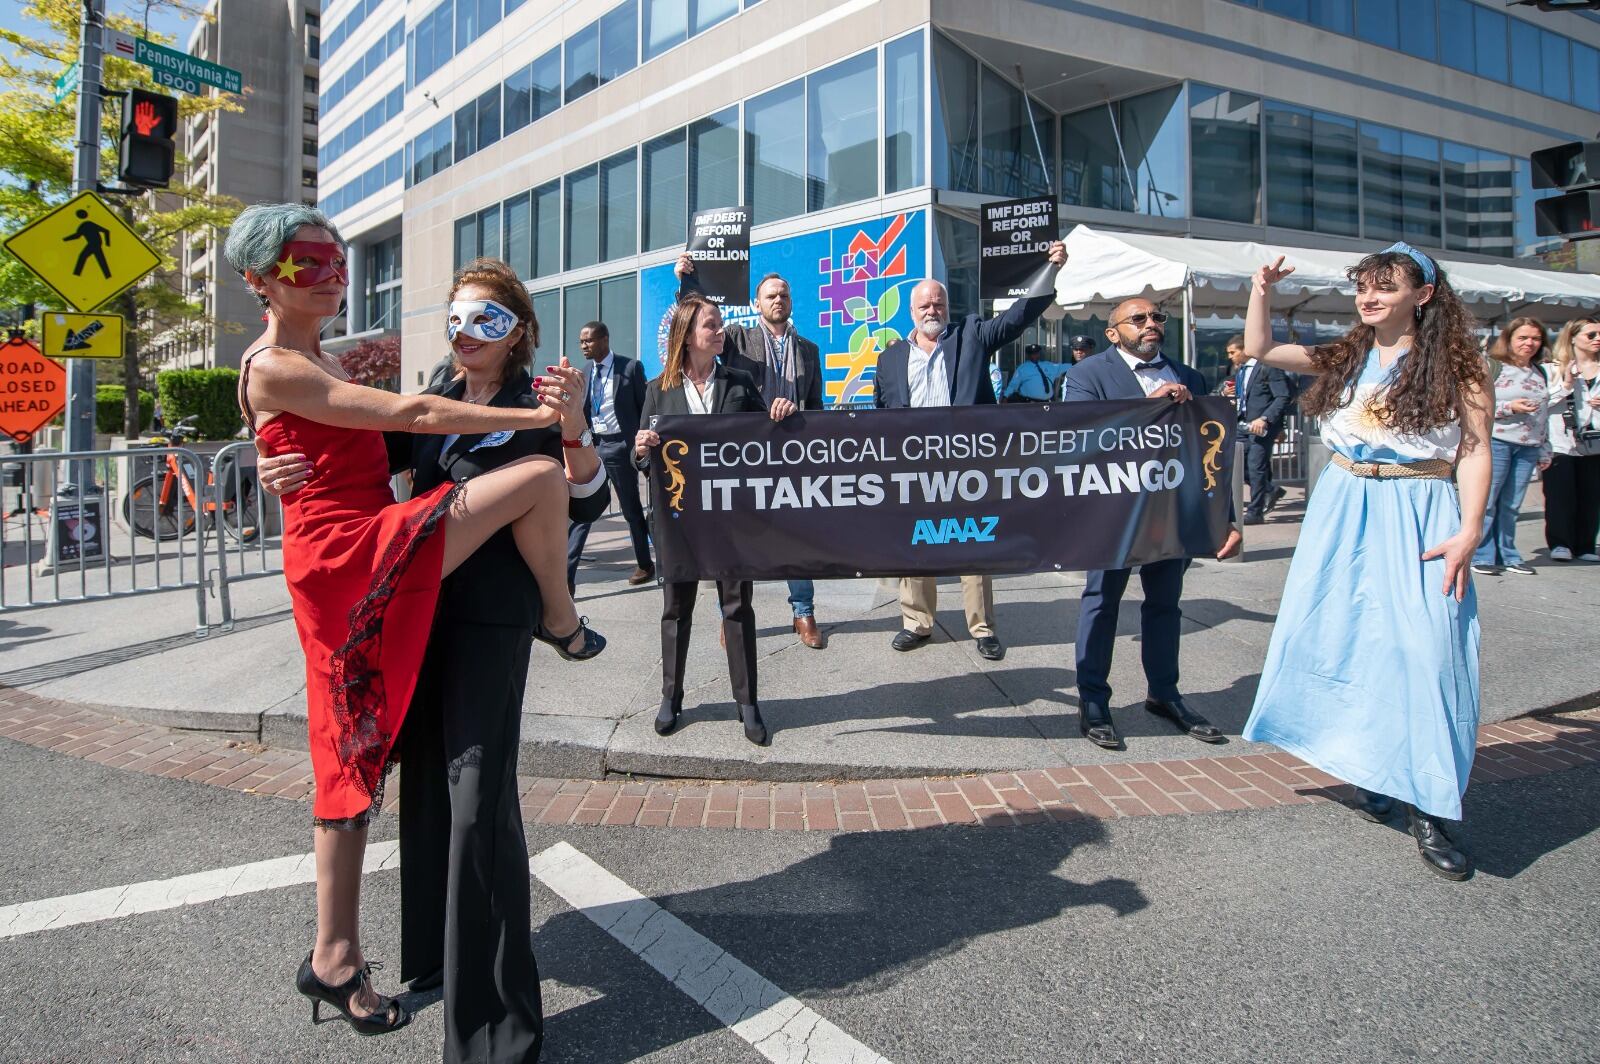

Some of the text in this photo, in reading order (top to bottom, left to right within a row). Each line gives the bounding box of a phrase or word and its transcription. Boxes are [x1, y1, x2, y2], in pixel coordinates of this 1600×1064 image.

[137, 42, 239, 84] Pennsylvania Ave
[157, 71, 196, 93] 1900
[224, 81, 239, 91] NW
[694, 211, 747, 226] IMF DEBT:
[987, 201, 1053, 220] IMF DEBT:
[695, 224, 742, 237] REFORM
[992, 214, 1049, 232] REFORM
[707, 237, 725, 248] OR
[1010, 230, 1032, 243] OR
[1007, 287, 1030, 296] AVAAZ
[700, 423, 1182, 467] ECOLOGICAL CRISIS / DEBT CRISIS
[701, 458, 1185, 511] IT TAKES TWO TO TANGO
[911, 516, 1000, 545] AVAAZ
